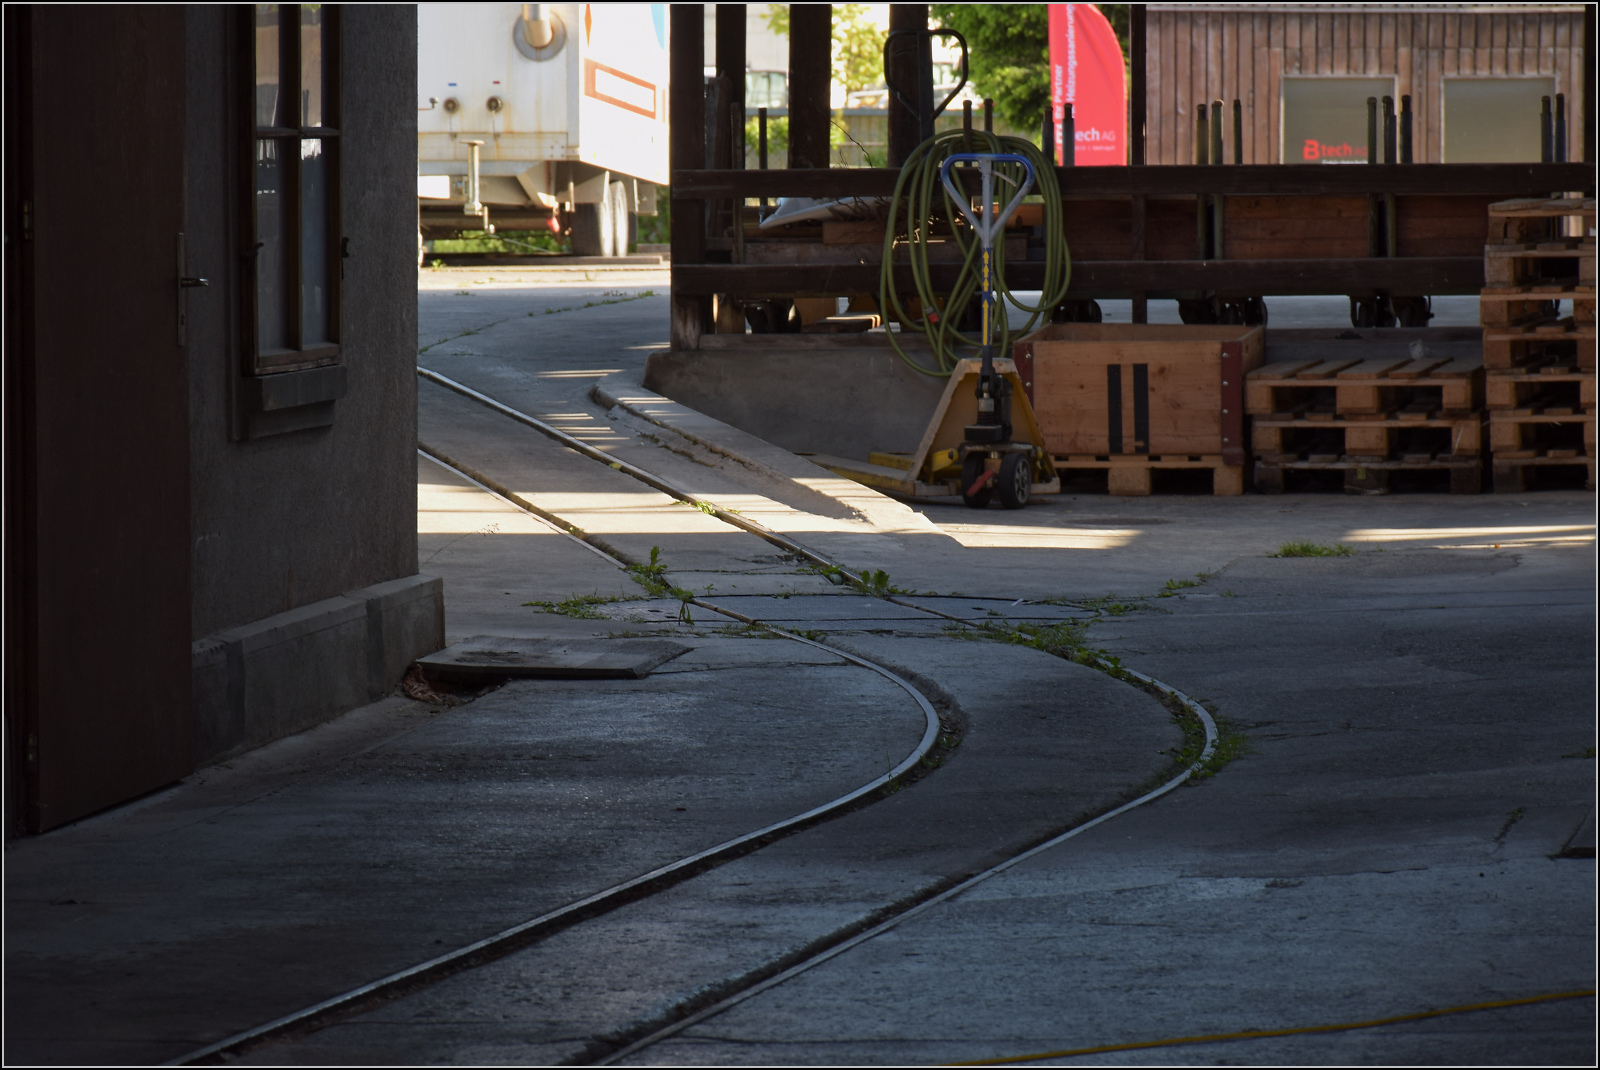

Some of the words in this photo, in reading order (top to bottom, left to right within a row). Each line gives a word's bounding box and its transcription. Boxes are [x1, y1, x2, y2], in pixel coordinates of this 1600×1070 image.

[1065, 4, 1077, 102] Heizungssanierung
[1054, 64, 1063, 103] Partner
[1101, 130, 1116, 142] AG
[1303, 139, 1353, 160] Btech
